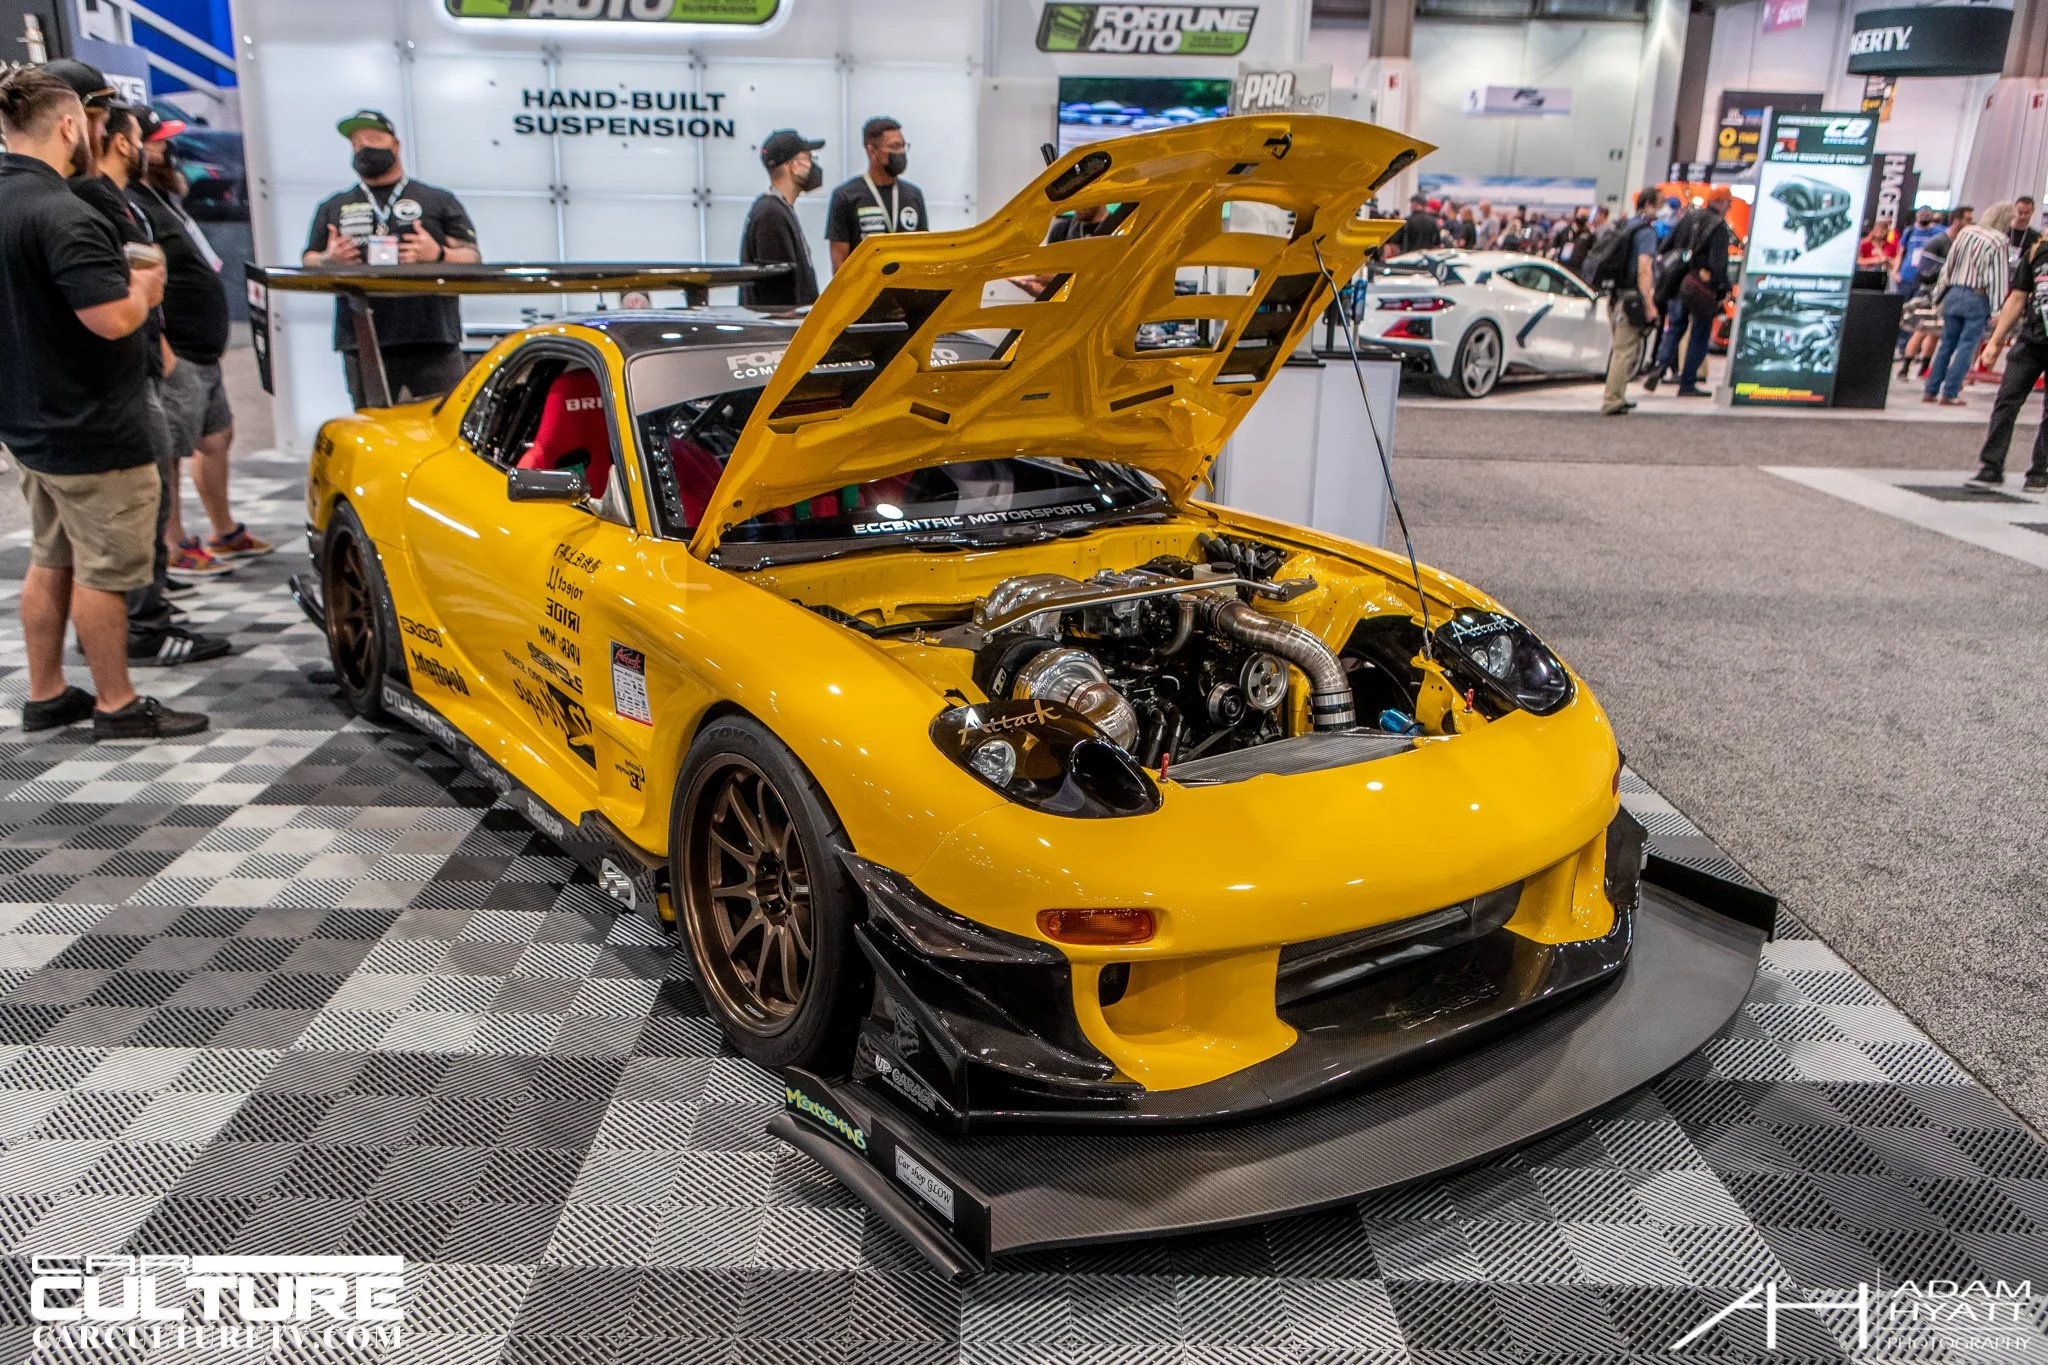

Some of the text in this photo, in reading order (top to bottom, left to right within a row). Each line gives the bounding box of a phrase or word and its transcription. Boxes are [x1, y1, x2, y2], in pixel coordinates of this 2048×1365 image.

[528, 0, 675, 21] AUTO
[1094, 6, 1256, 32] FORTUNE
[1088, 29, 1184, 53] AUTO
[522, 88, 726, 113] HAND-BUILT
[1241, 71, 1296, 109] PRO
[513, 114, 736, 138] SUSPENSION
[853, 502, 1096, 535] ECCENTRIC MOTORSPORTS
[1450, 612, 1516, 645] Attack
[957, 699, 1062, 746] Attack
[875, 1054, 893, 1076] UP
[891, 1067, 937, 1112] GARAGE
[897, 1155, 911, 1171] Car
[910, 1166, 926, 1186] shop
[926, 1179, 952, 1204] GLOW
